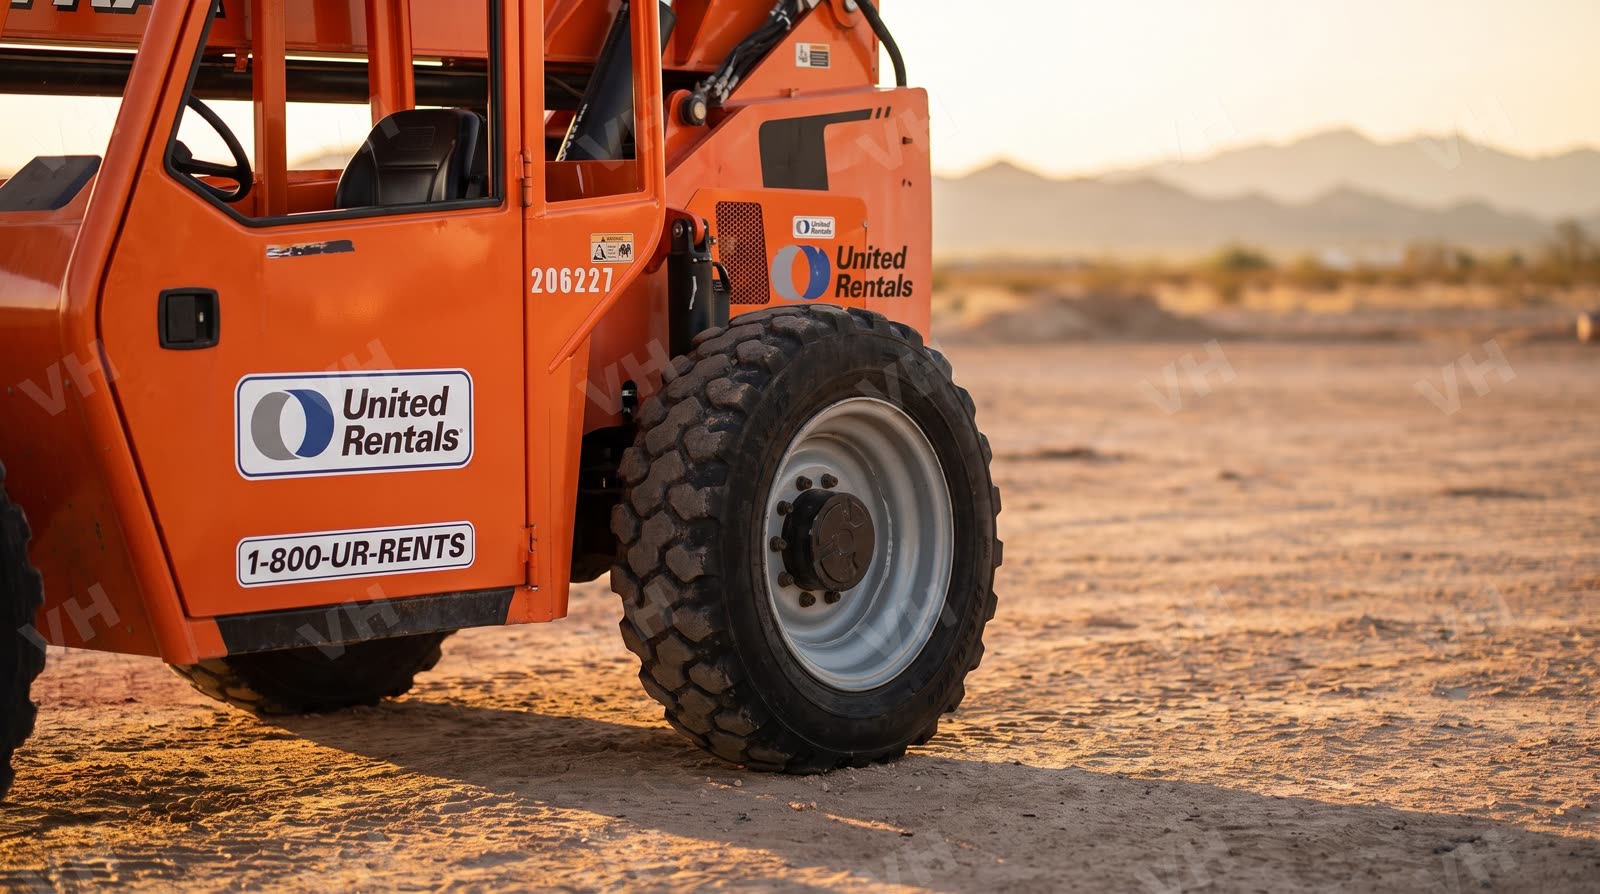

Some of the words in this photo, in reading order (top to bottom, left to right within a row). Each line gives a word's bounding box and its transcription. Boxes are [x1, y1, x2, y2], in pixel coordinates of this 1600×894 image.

[811, 220, 831, 228] United
[836, 245, 908, 270] United
[531, 267, 613, 294] 206227
[835, 273, 913, 298] Rentals
[343, 385, 450, 420] United
[247, 532, 466, 575] 1-800-UR-RENTS
